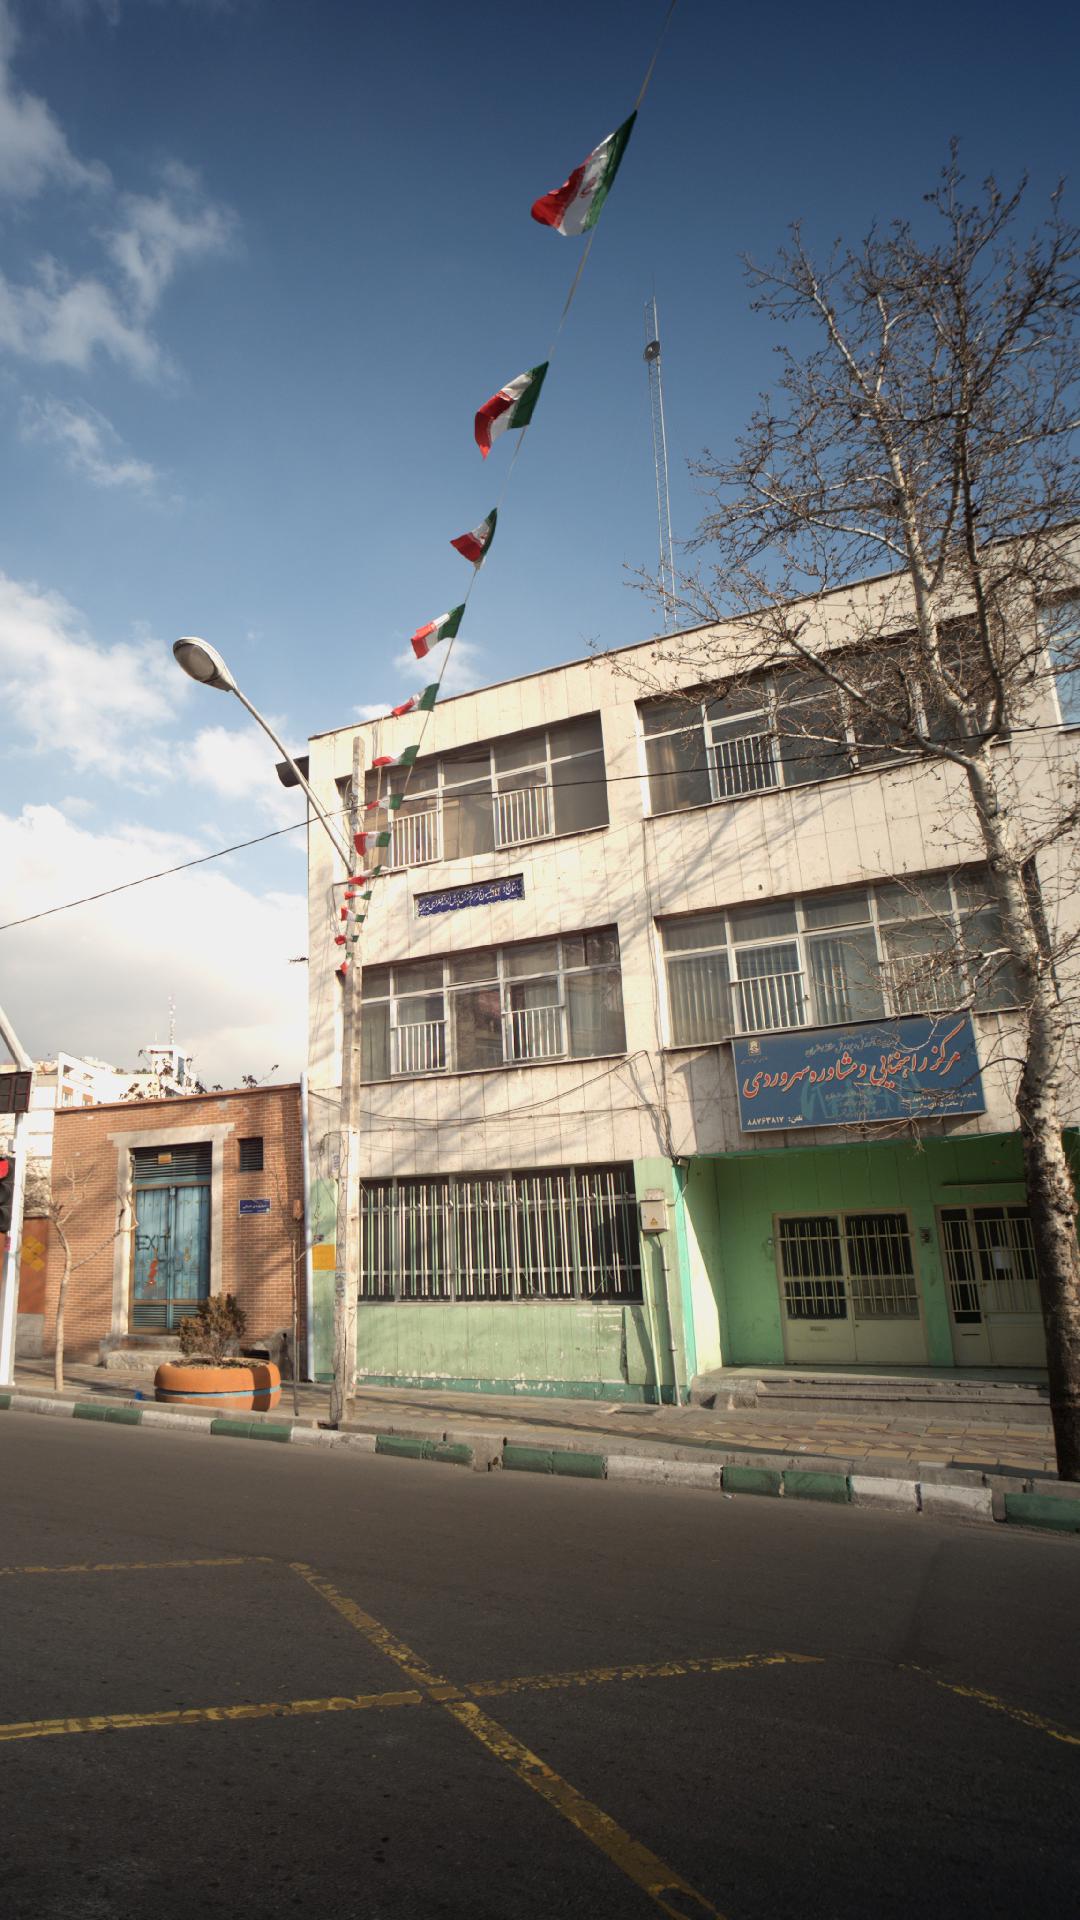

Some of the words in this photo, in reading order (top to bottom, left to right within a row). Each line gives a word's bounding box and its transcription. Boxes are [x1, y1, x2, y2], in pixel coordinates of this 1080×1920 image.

[929, 1018, 966, 1076] مرکز
[742, 1065, 811, 1099] سهروردی
[809, 1051, 858, 1083] مشاوره
[857, 1063, 867, 1079] و
[136, 1234, 171, 1252] EXIT
